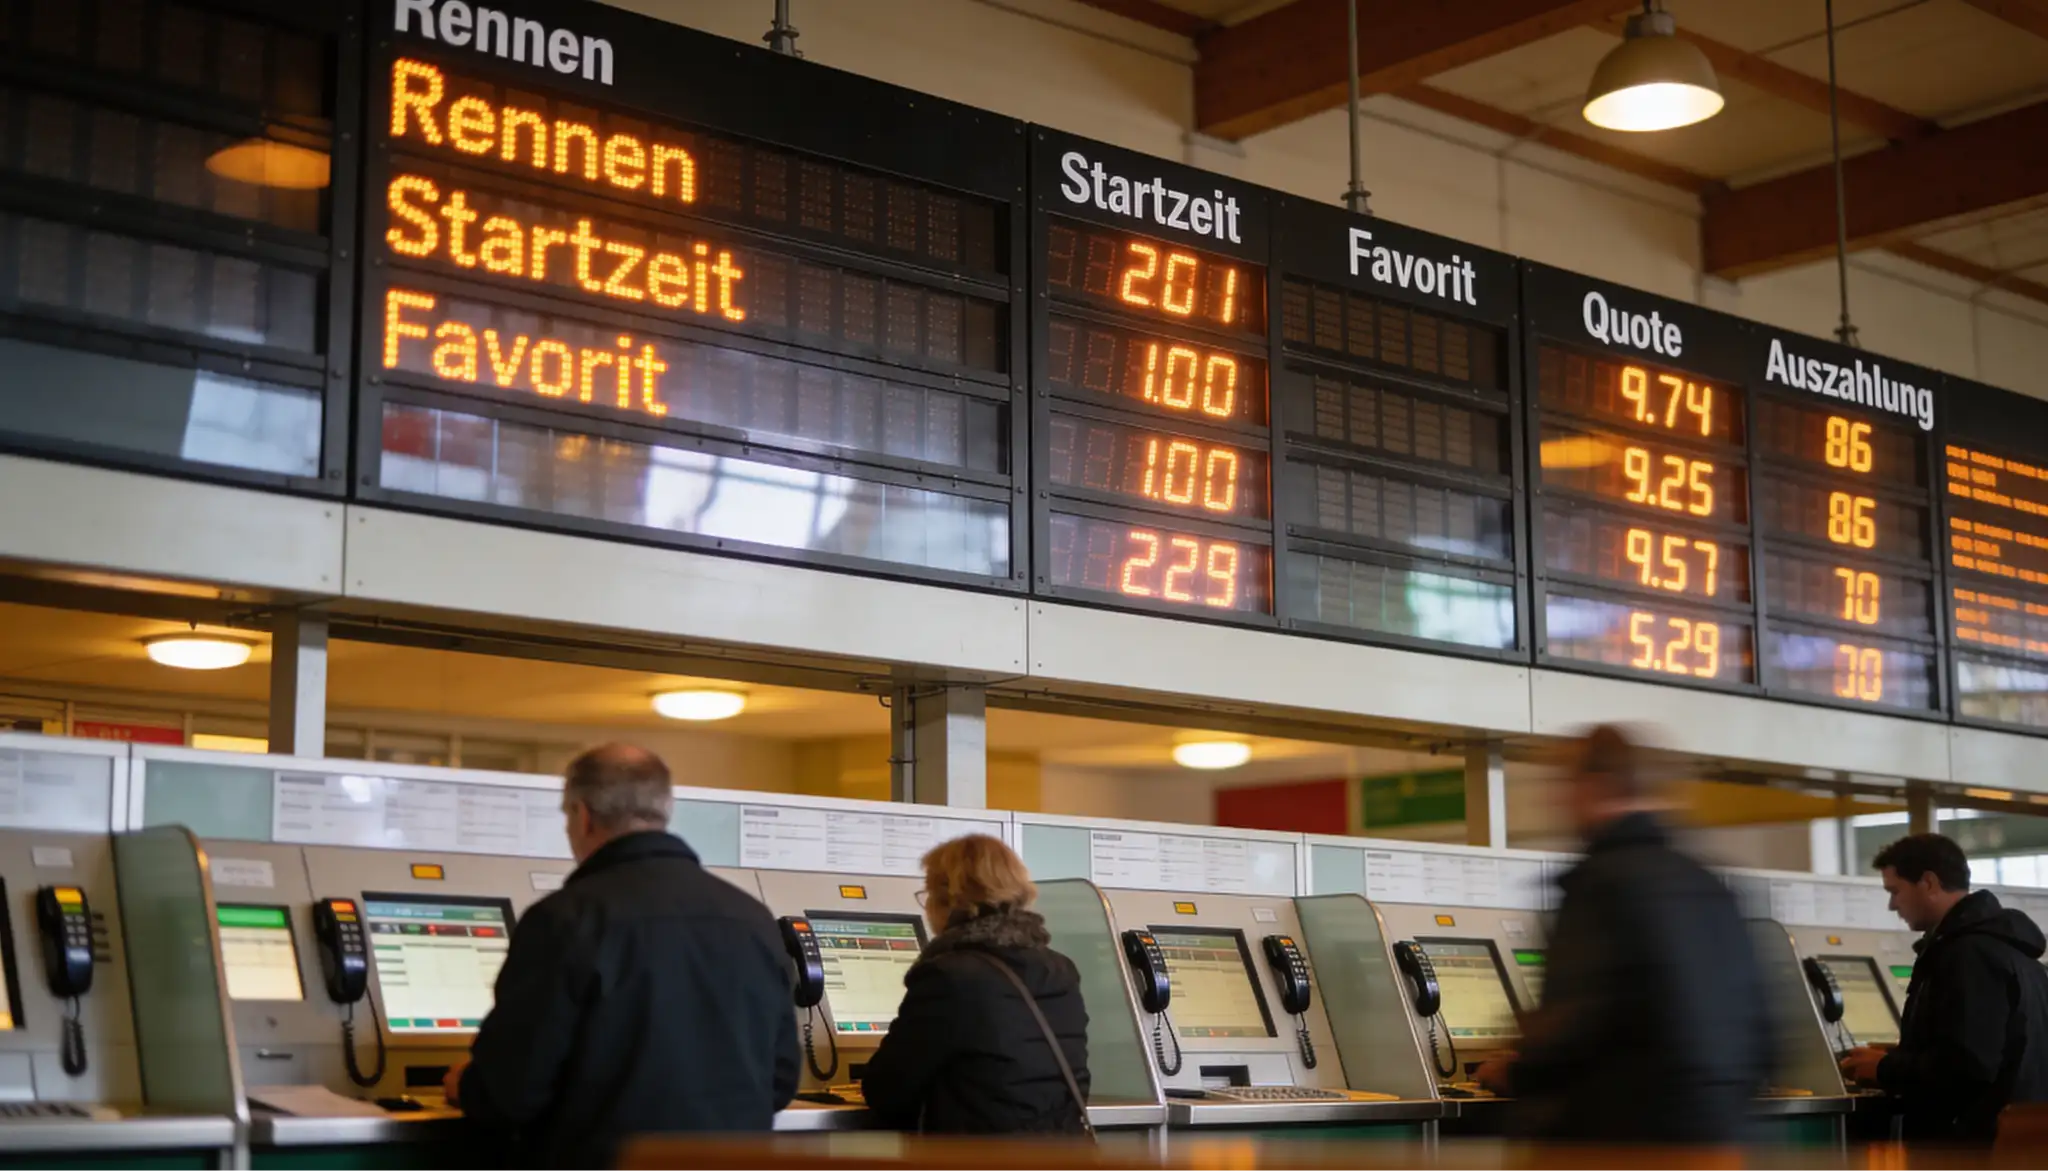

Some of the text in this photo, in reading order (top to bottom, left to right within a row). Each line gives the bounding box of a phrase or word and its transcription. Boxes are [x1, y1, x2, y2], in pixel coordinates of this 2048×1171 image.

[395, 0, 614, 86] Rennen
[390, 57, 697, 203] Rennen
[1061, 152, 1241, 244] Startzeit
[386, 173, 746, 322] Startzeit
[1349, 227, 1477, 306] Favorit
[383, 288, 669, 417] Favorit
[1583, 291, 1682, 358] Quote
[1144, 344, 1237, 417] 1.00
[1621, 366, 1712, 436] 9.74
[1766, 339, 1934, 431] Auszahlung
[1144, 439, 1237, 511] 1.00
[1826, 416, 1873, 473] 86
[1624, 447, 1714, 517] 9.25
[1829, 492, 1876, 549] 86
[1122, 532, 1237, 607] 229
[1627, 528, 1718, 597] 9.57
[1835, 567, 1880, 625] 70
[1630, 612, 1720, 678] 5.29
